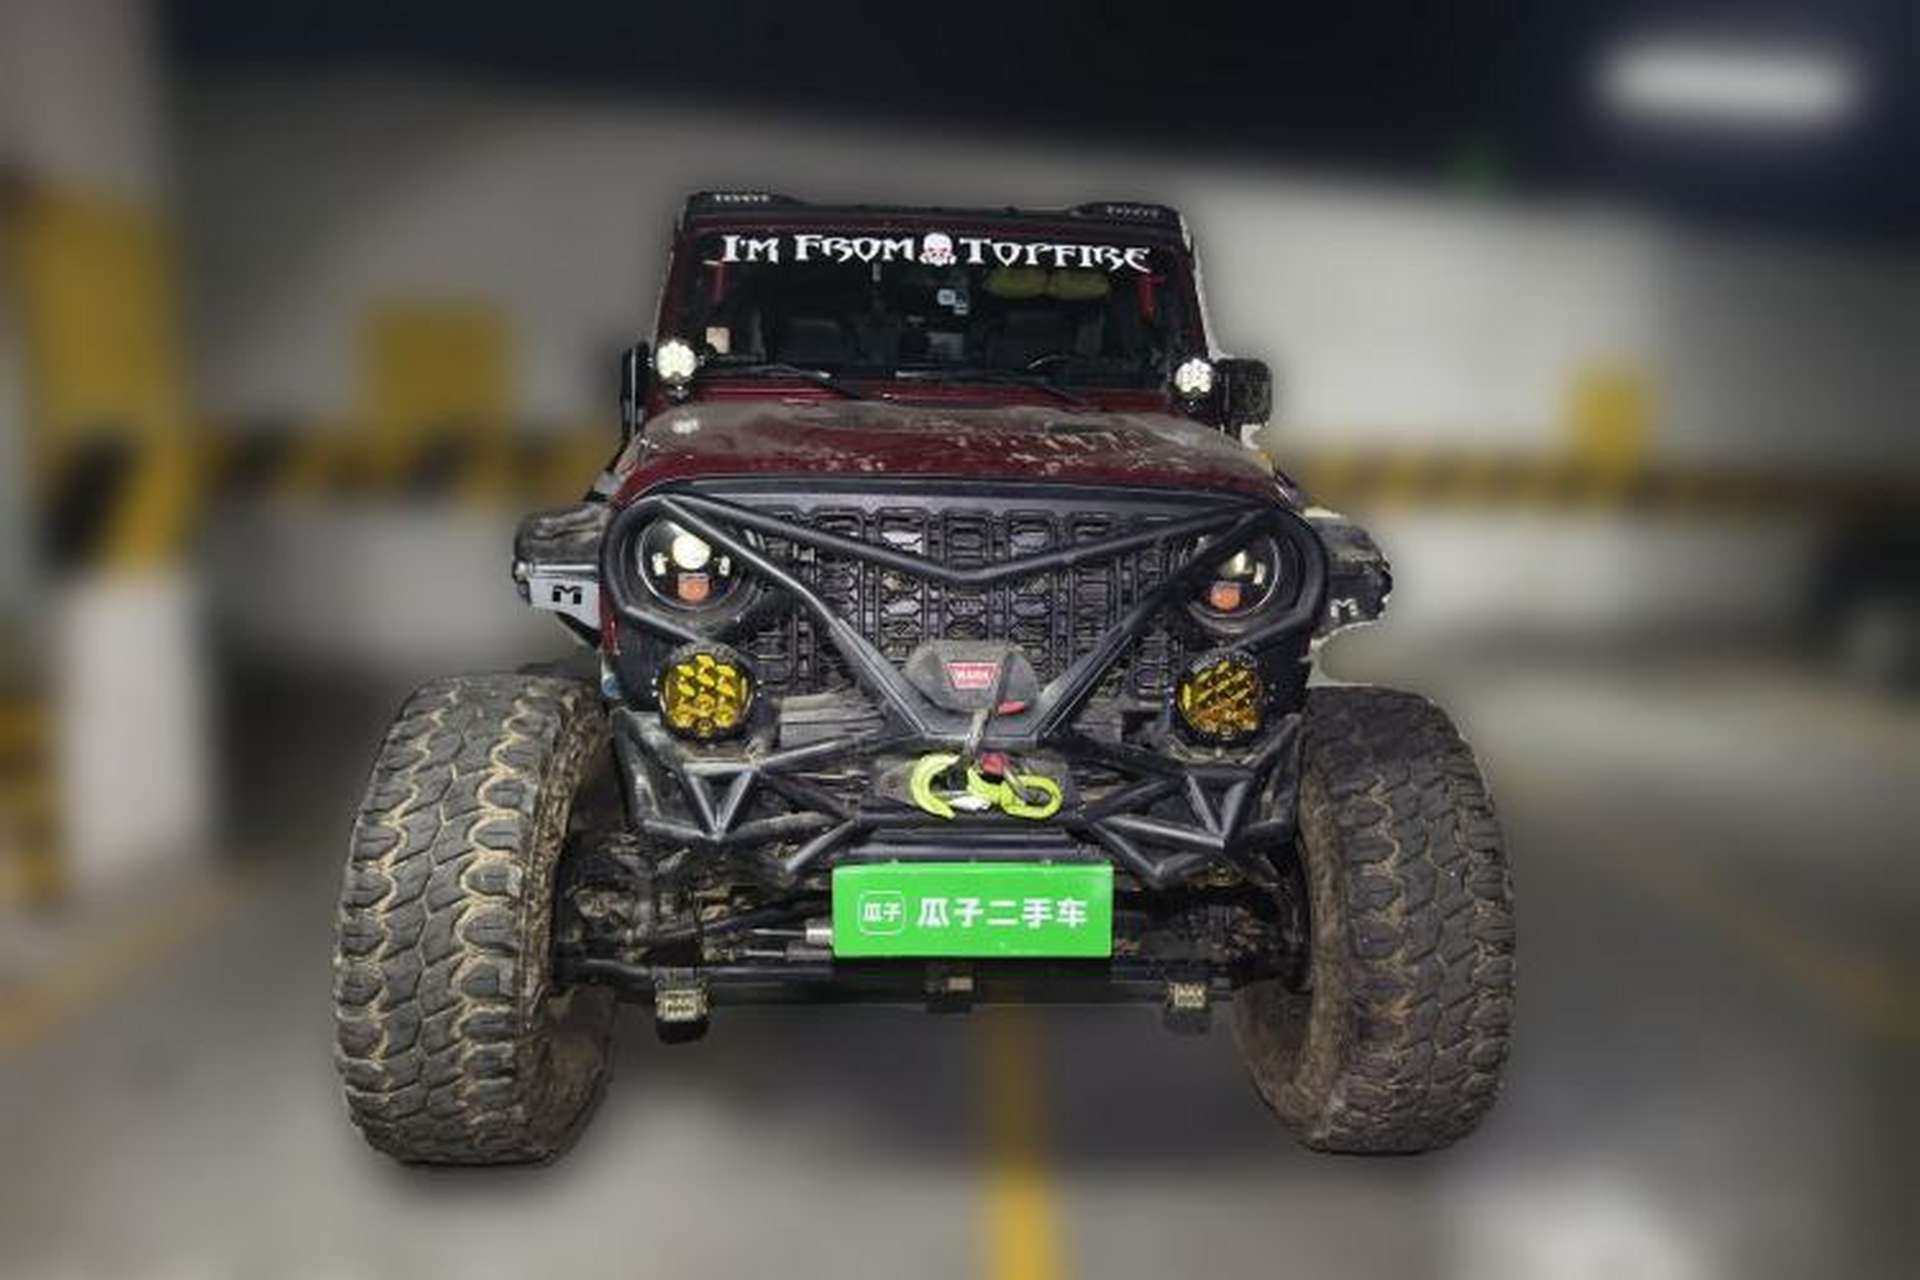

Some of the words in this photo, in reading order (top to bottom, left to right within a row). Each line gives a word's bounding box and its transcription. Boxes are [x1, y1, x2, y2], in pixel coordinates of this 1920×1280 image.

[722, 234, 779, 264] I'M
[794, 234, 915, 263] FROM
[863, 902, 902, 923] 瓜子
[917, 897, 1087, 929] 瓜子二手车
